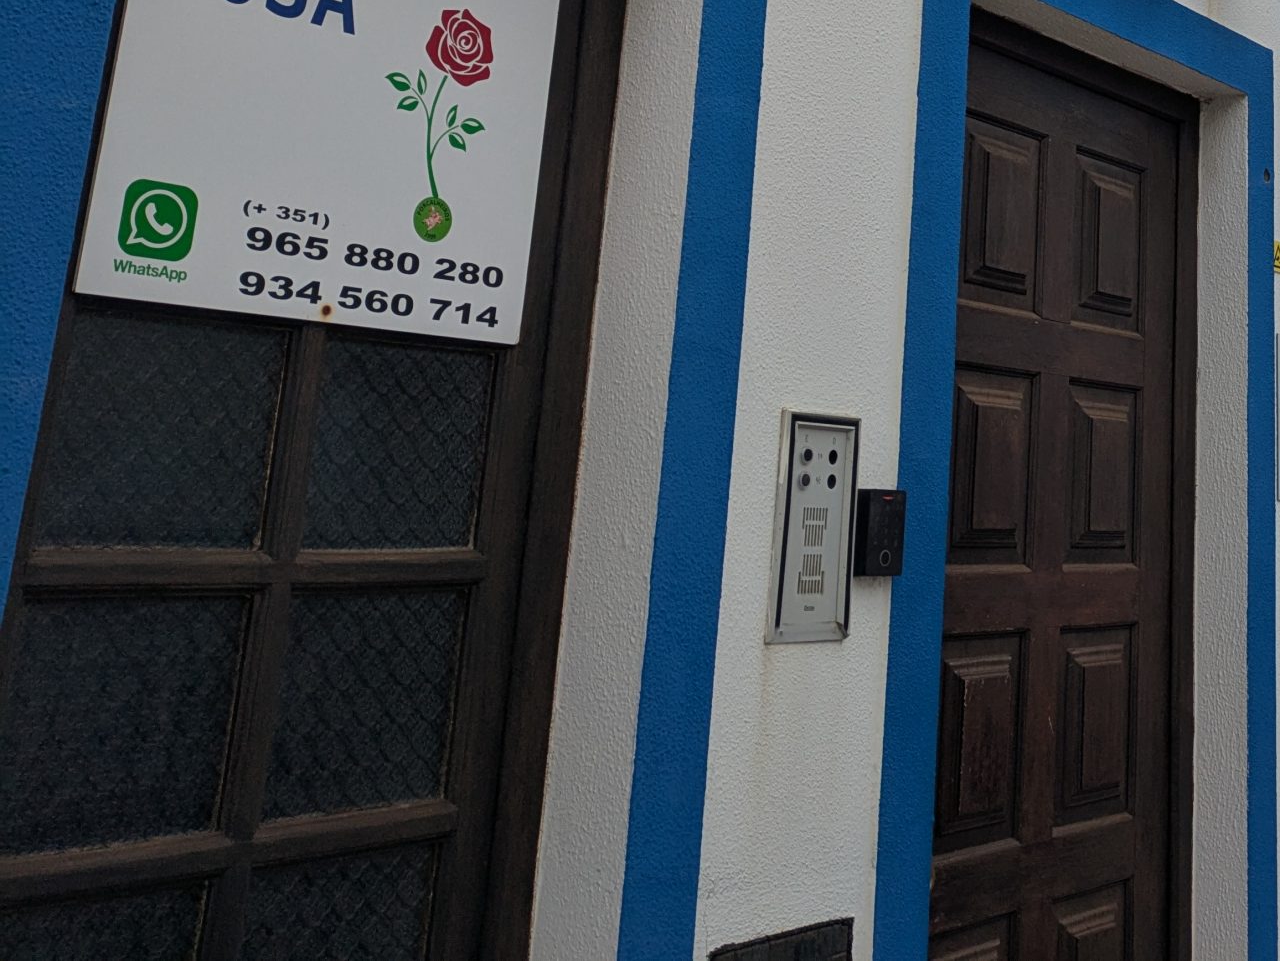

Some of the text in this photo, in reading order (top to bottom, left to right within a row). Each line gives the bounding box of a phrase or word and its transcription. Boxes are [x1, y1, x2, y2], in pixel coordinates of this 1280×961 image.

[113, 258, 188, 283] WhatsApp
[246, 227, 504, 288] 965 880 280
[239, 271, 499, 328] 934 560 714
